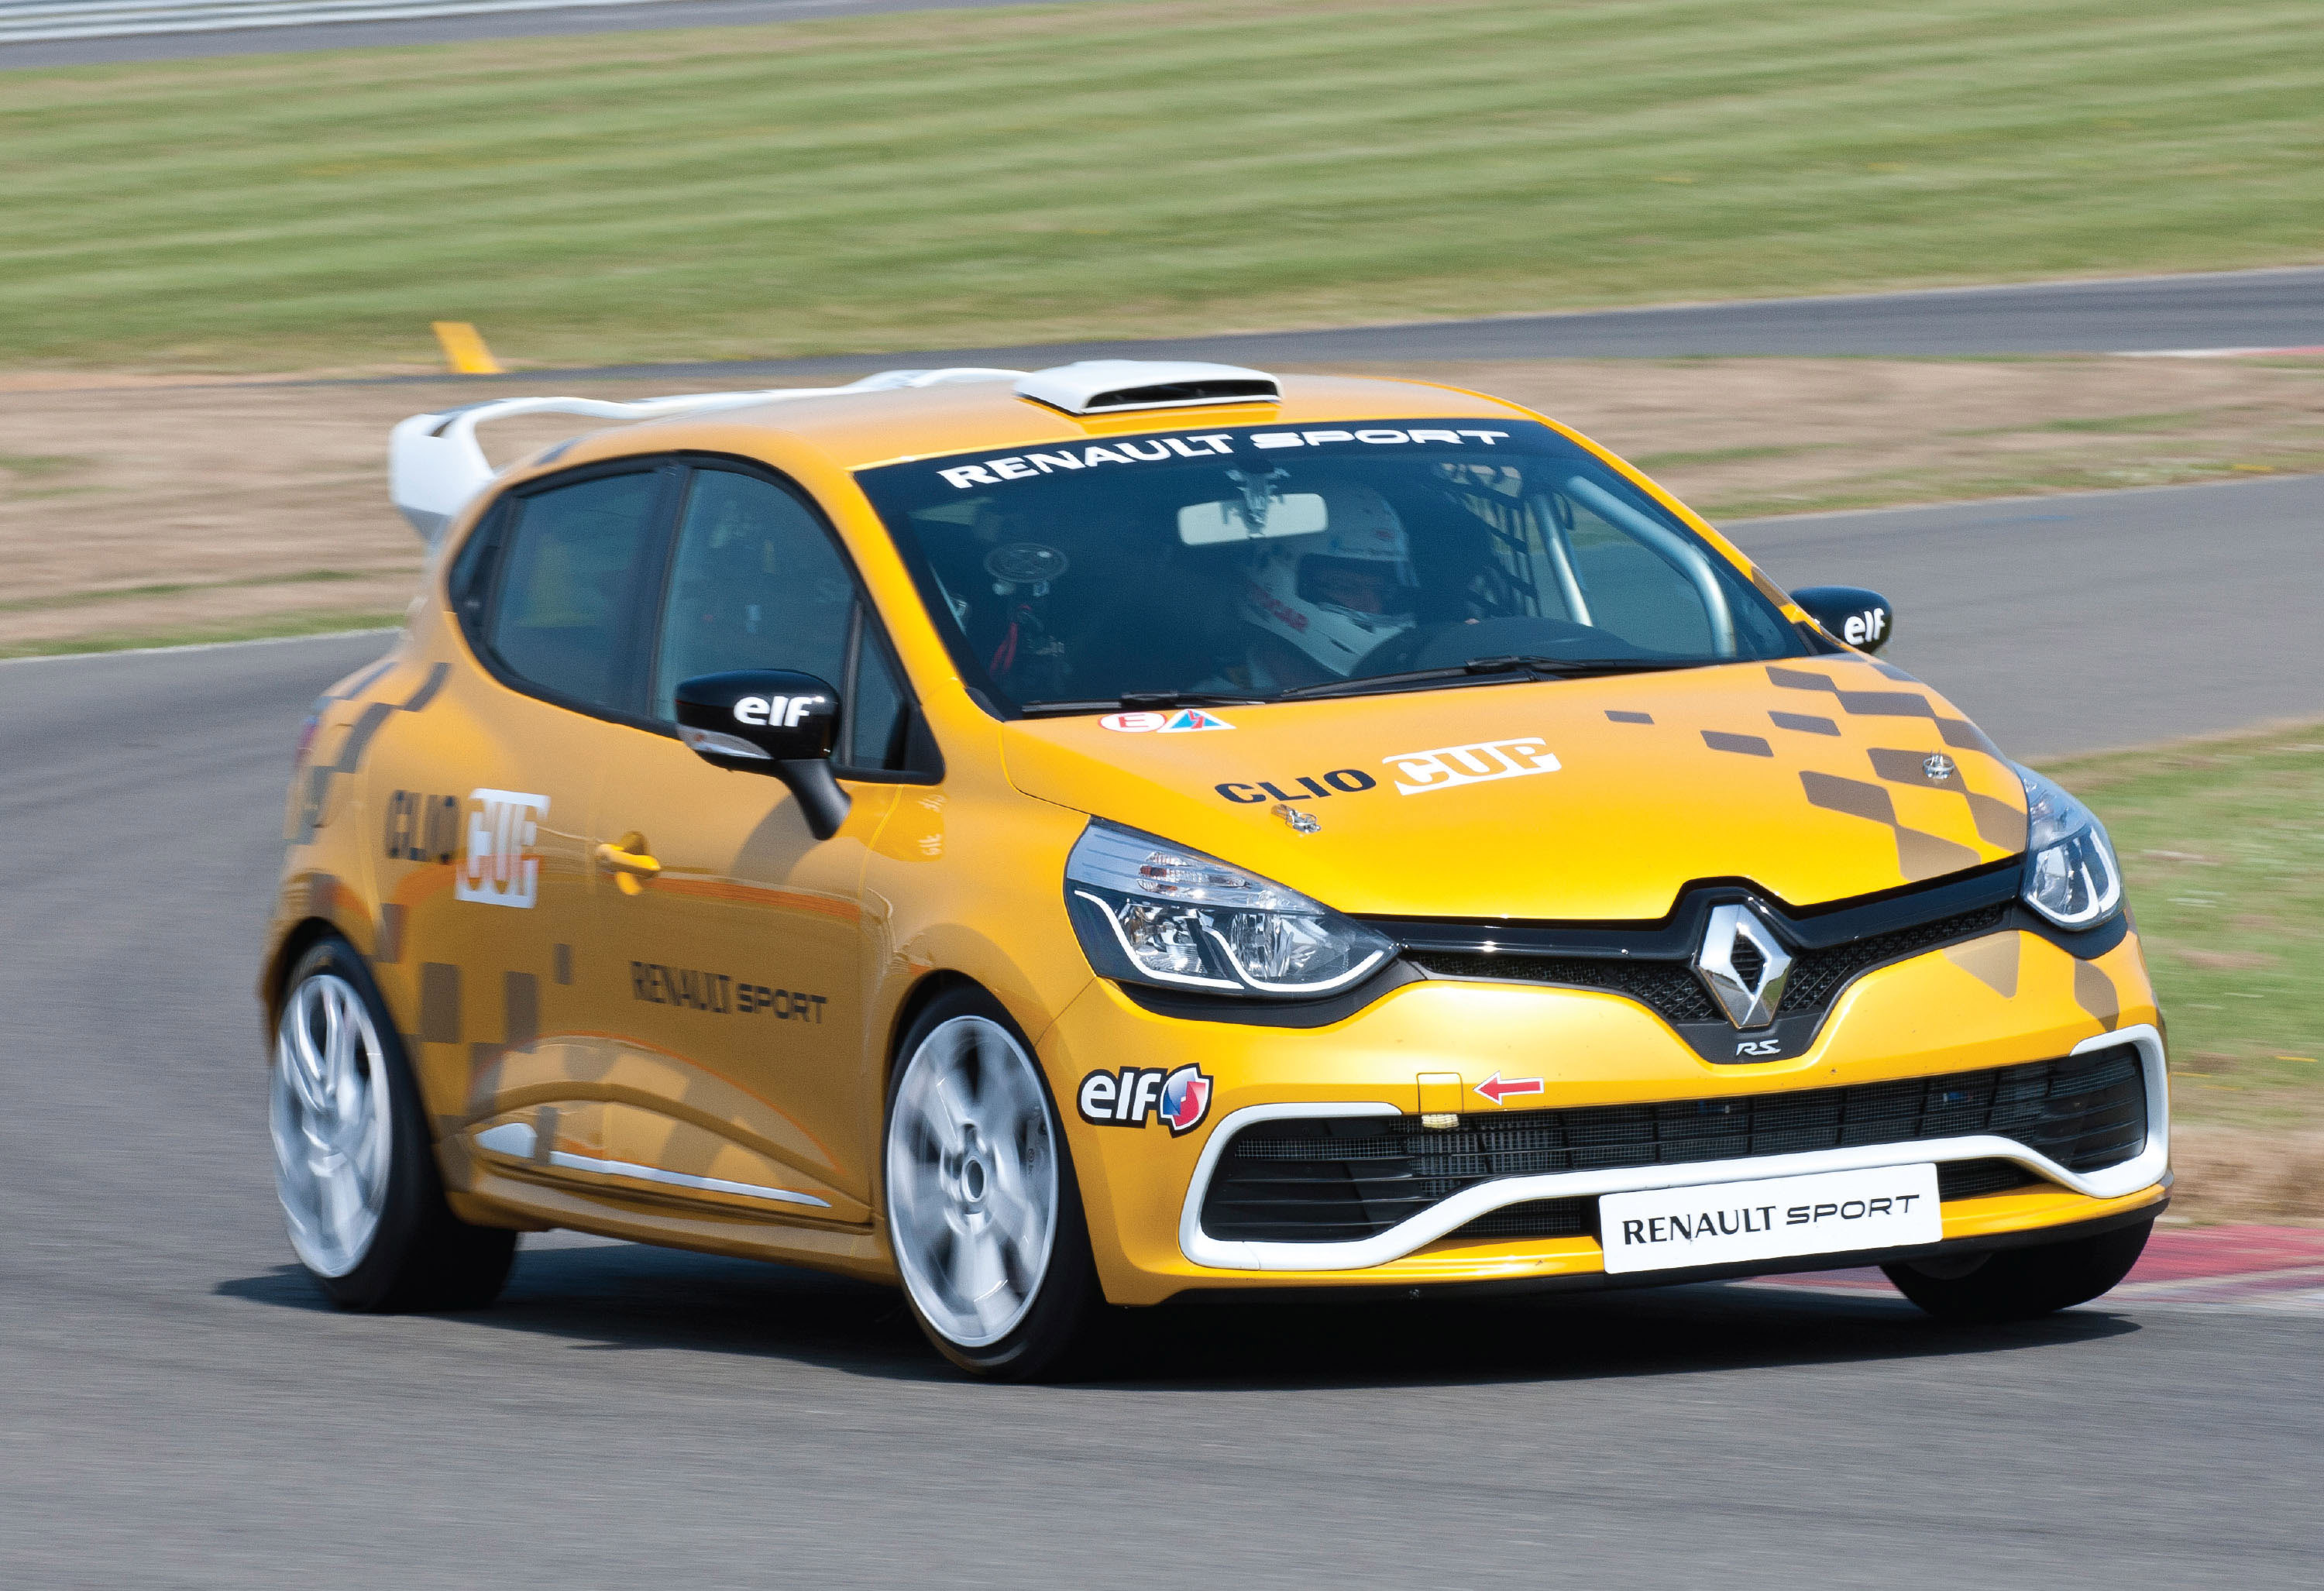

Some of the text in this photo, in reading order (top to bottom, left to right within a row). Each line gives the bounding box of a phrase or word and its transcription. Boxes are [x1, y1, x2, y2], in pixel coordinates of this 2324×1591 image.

[937, 429, 1510, 490] RENAULT SPORT
[1844, 607, 1885, 645] elf
[733, 696, 813, 727] elf
[1117, 713, 1150, 728] E
[1214, 741, 1556, 804] CLIO CUP
[737, 983, 828, 1024] SPORT
[1736, 1039, 1782, 1056] RS
[1081, 1072, 1162, 1121] elf
[1621, 1194, 1920, 1246] RENAULT SPORT
